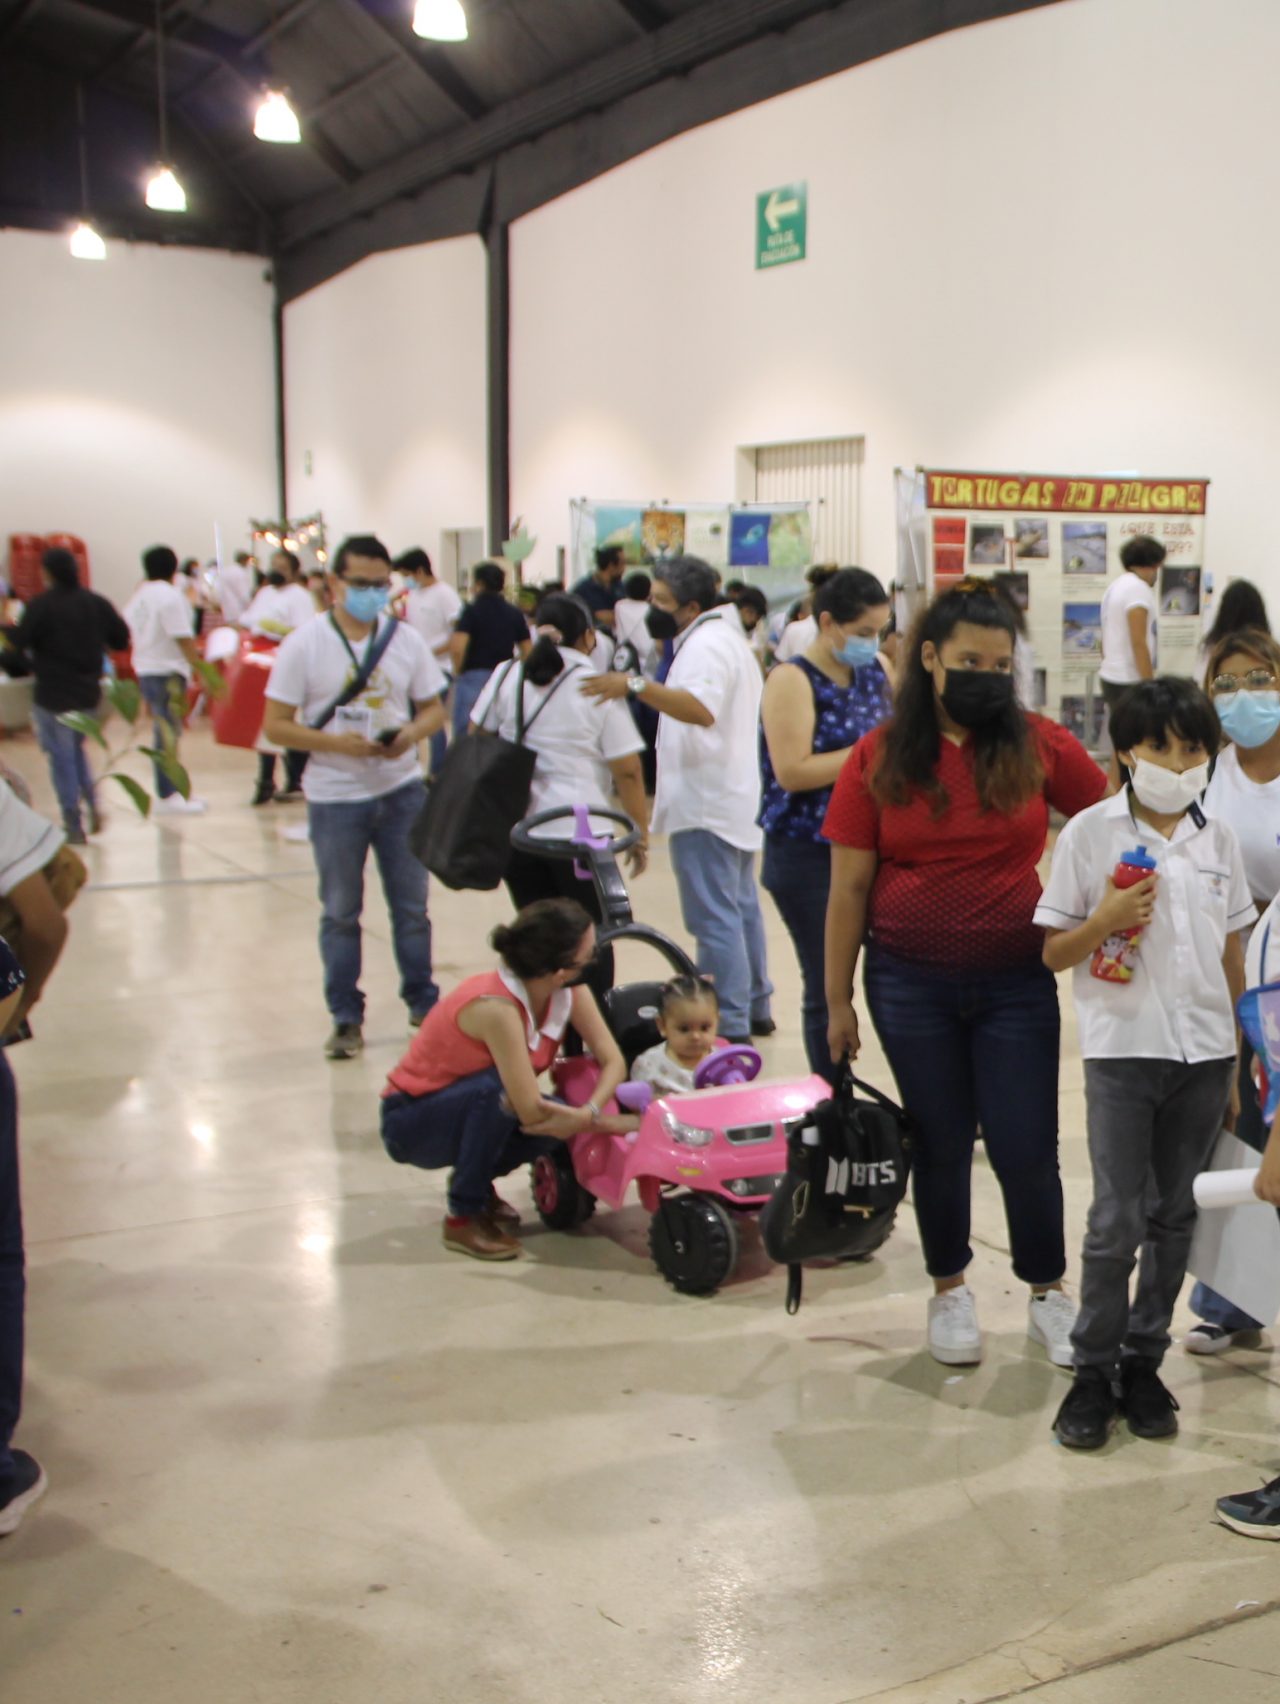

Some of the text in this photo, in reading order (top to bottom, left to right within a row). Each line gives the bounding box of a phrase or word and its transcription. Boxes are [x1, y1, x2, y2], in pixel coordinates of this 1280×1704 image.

[931, 476, 1202, 511] TORTUGAS EN PELIGRO
[852, 1160, 896, 1187] BTS
